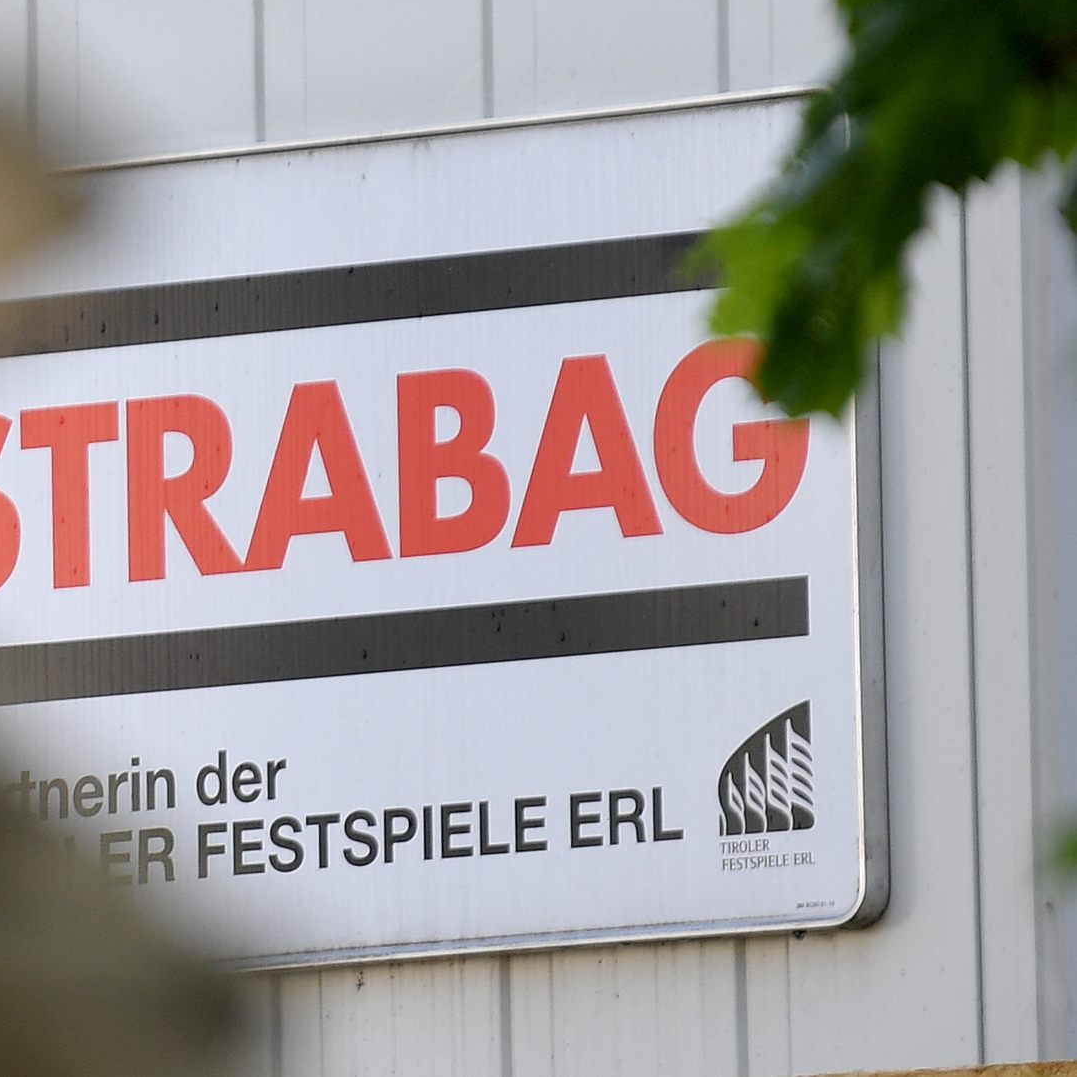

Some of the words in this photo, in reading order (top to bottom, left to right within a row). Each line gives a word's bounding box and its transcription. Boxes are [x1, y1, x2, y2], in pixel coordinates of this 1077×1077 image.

[6, 756, 175, 821] tnerin
[196, 749, 287, 807] der
[198, 795, 548, 879] FESTSPIELE
[570, 786, 684, 848] ERL
[720, 839, 770, 854] TIROLER
[722, 854, 789, 871] FESTSPIELE
[794, 852, 815, 865] ERL
